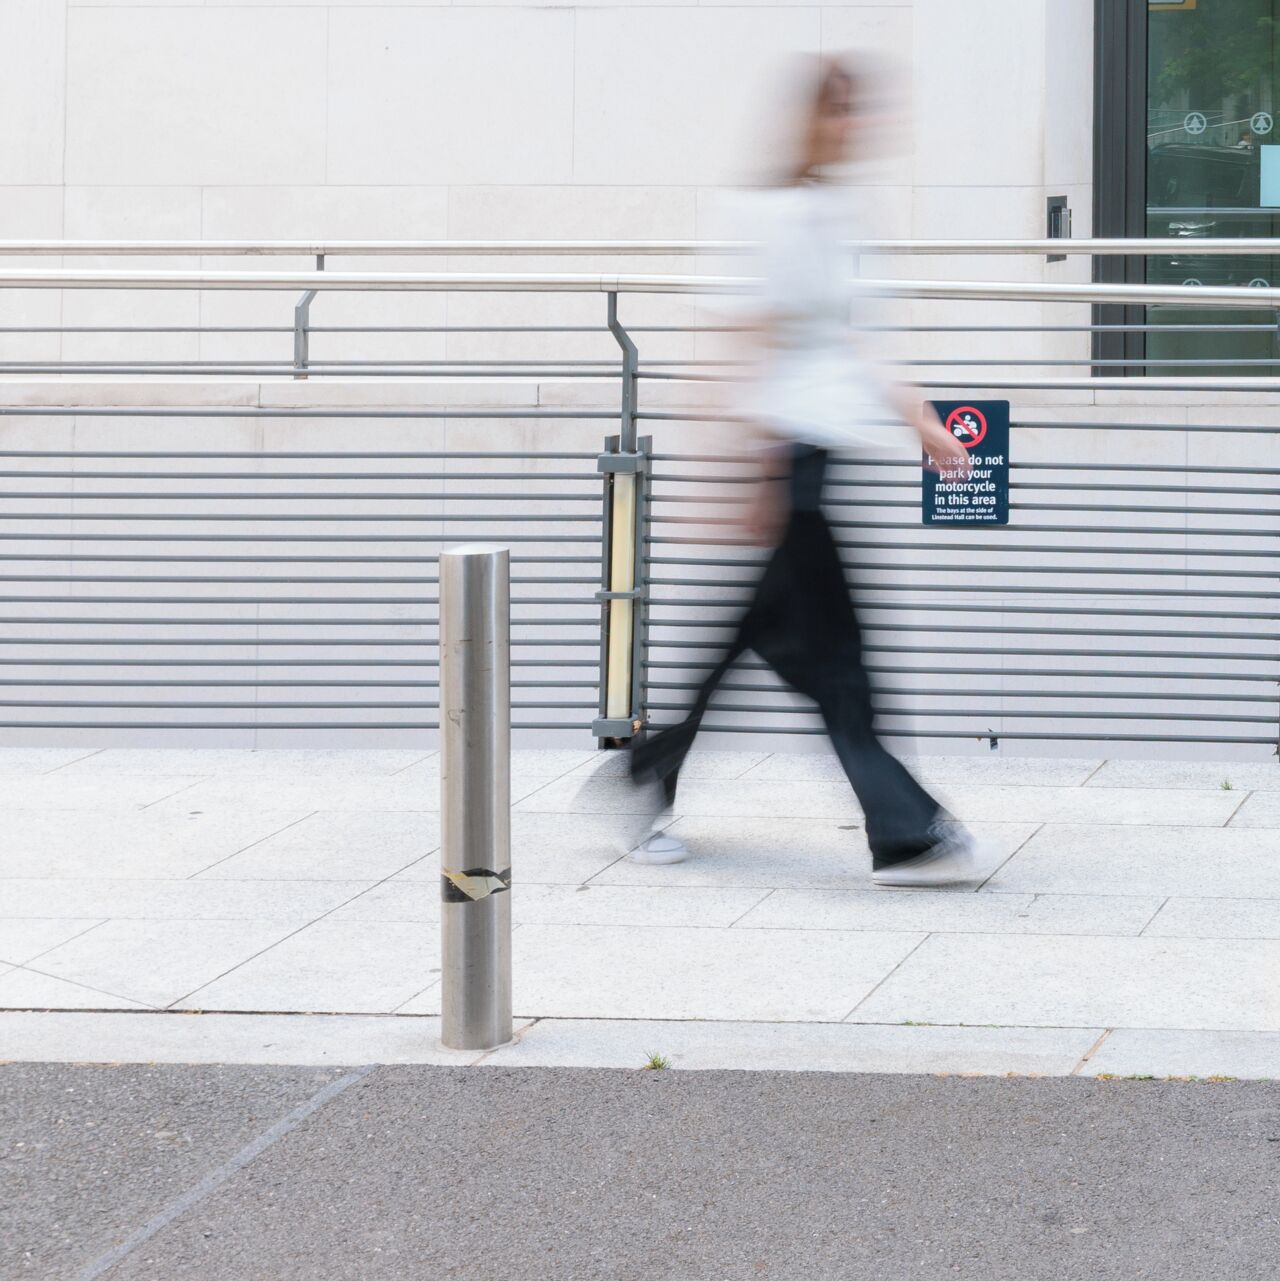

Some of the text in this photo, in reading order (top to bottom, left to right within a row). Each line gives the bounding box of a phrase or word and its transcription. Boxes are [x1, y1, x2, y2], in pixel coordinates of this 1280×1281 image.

[968, 454, 982, 465] do
[985, 455, 1003, 465] not
[939, 468, 992, 481] park your
[935, 481, 996, 494] motorcycle
[934, 494, 996, 505] in this area
